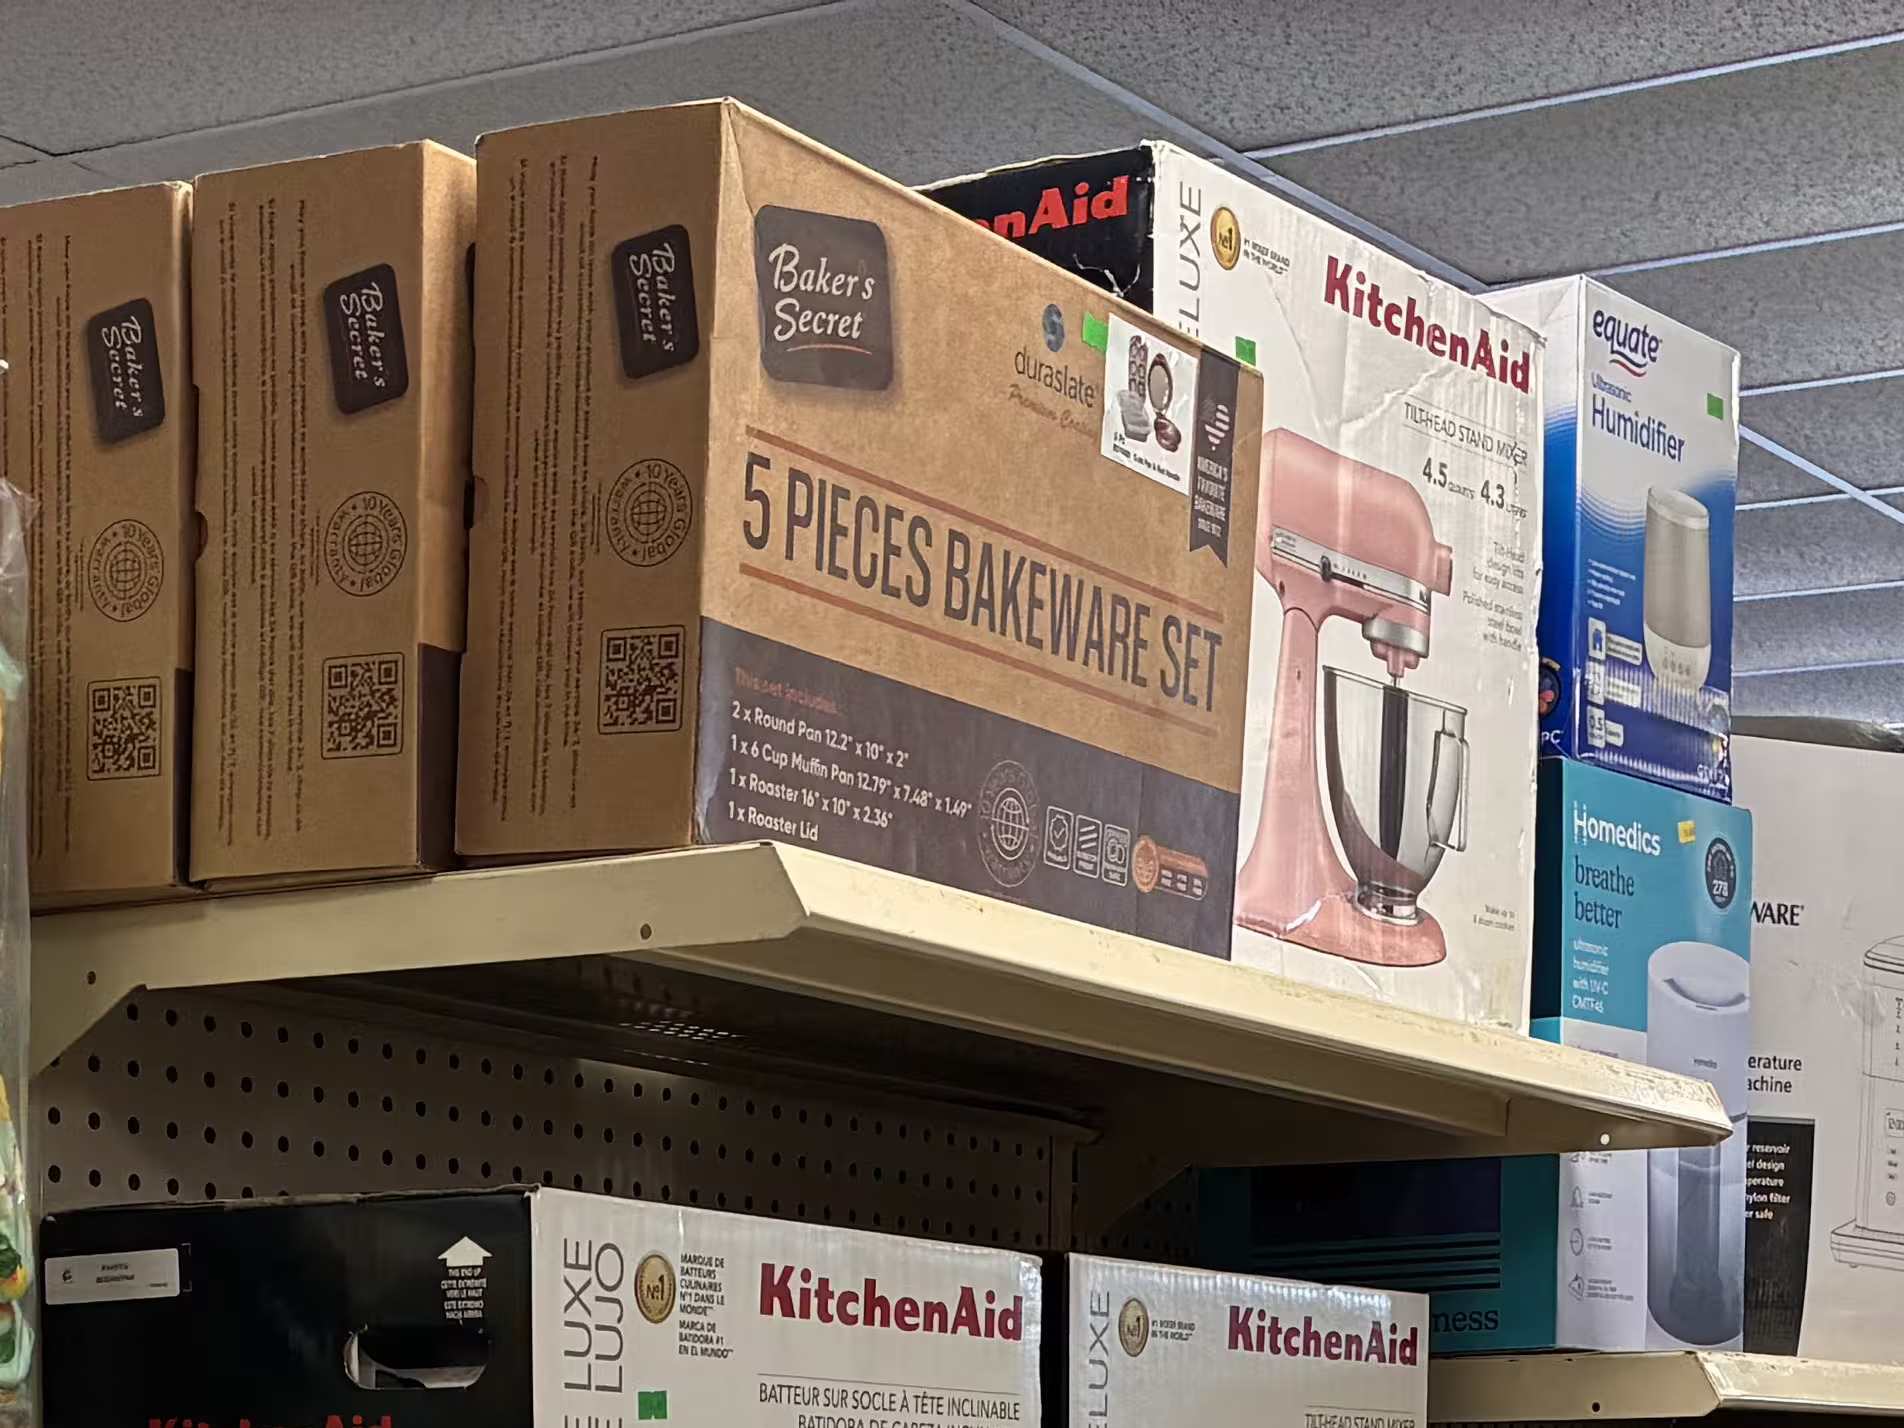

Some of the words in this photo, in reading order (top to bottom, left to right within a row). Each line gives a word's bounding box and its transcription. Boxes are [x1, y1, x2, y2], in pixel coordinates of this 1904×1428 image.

[628, 253, 657, 346] Secret
[649, 239, 677, 353] Baker's
[769, 242, 875, 301] Baker's
[339, 292, 368, 382] Secret
[360, 281, 387, 390] Baker's
[773, 298, 863, 340] Secret
[1324, 255, 1530, 394] KitchenAid
[1592, 306, 1660, 363] equate
[100, 325, 129, 413] Secret
[119, 315, 145, 419] Baker's
[1014, 346, 1095, 408] duraslate
[1591, 371, 1632, 403] Ultrasonic
[1591, 393, 1684, 463] Humidifier
[743, 451, 772, 551] 5
[785, 467, 932, 608] PIECES
[943, 530, 1149, 690] BAKEWARE
[1160, 614, 1222, 712] SET
[732, 701, 740, 719] 2
[743, 709, 751, 723] x
[755, 708, 794, 735] Round
[798, 721, 822, 743] Pan
[856, 741, 862, 756] x
[866, 741, 884, 760] 10"
[886, 752, 894, 765] x
[728, 801, 734, 819] 1
[737, 808, 745, 822] x
[748, 806, 797, 836] Roaster
[800, 820, 819, 841] Lid
[1573, 800, 1661, 857] Homedics
[1574, 854, 1635, 896] breathe
[1574, 892, 1622, 929] better
[1573, 958, 1609, 975] humidifier
[1753, 1144, 1790, 1154] reservoir
[1756, 1160, 1785, 1172] design
[1755, 1210, 1773, 1219] safe
[563, 1236, 596, 1396] LUXE
[594, 1242, 625, 1396] LUJO
[758, 1262, 1024, 1343] KitchenAid
[1228, 1305, 1418, 1366] KitchenAid
[759, 1383, 820, 1406] BATTEUR
[823, 1388, 848, 1409] SUR
[852, 1390, 896, 1412] SOCLE
[900, 1389, 910, 1413] À
[913, 1392, 944, 1416] TÊTE
[947, 1397, 1020, 1421] INCLINABLE
